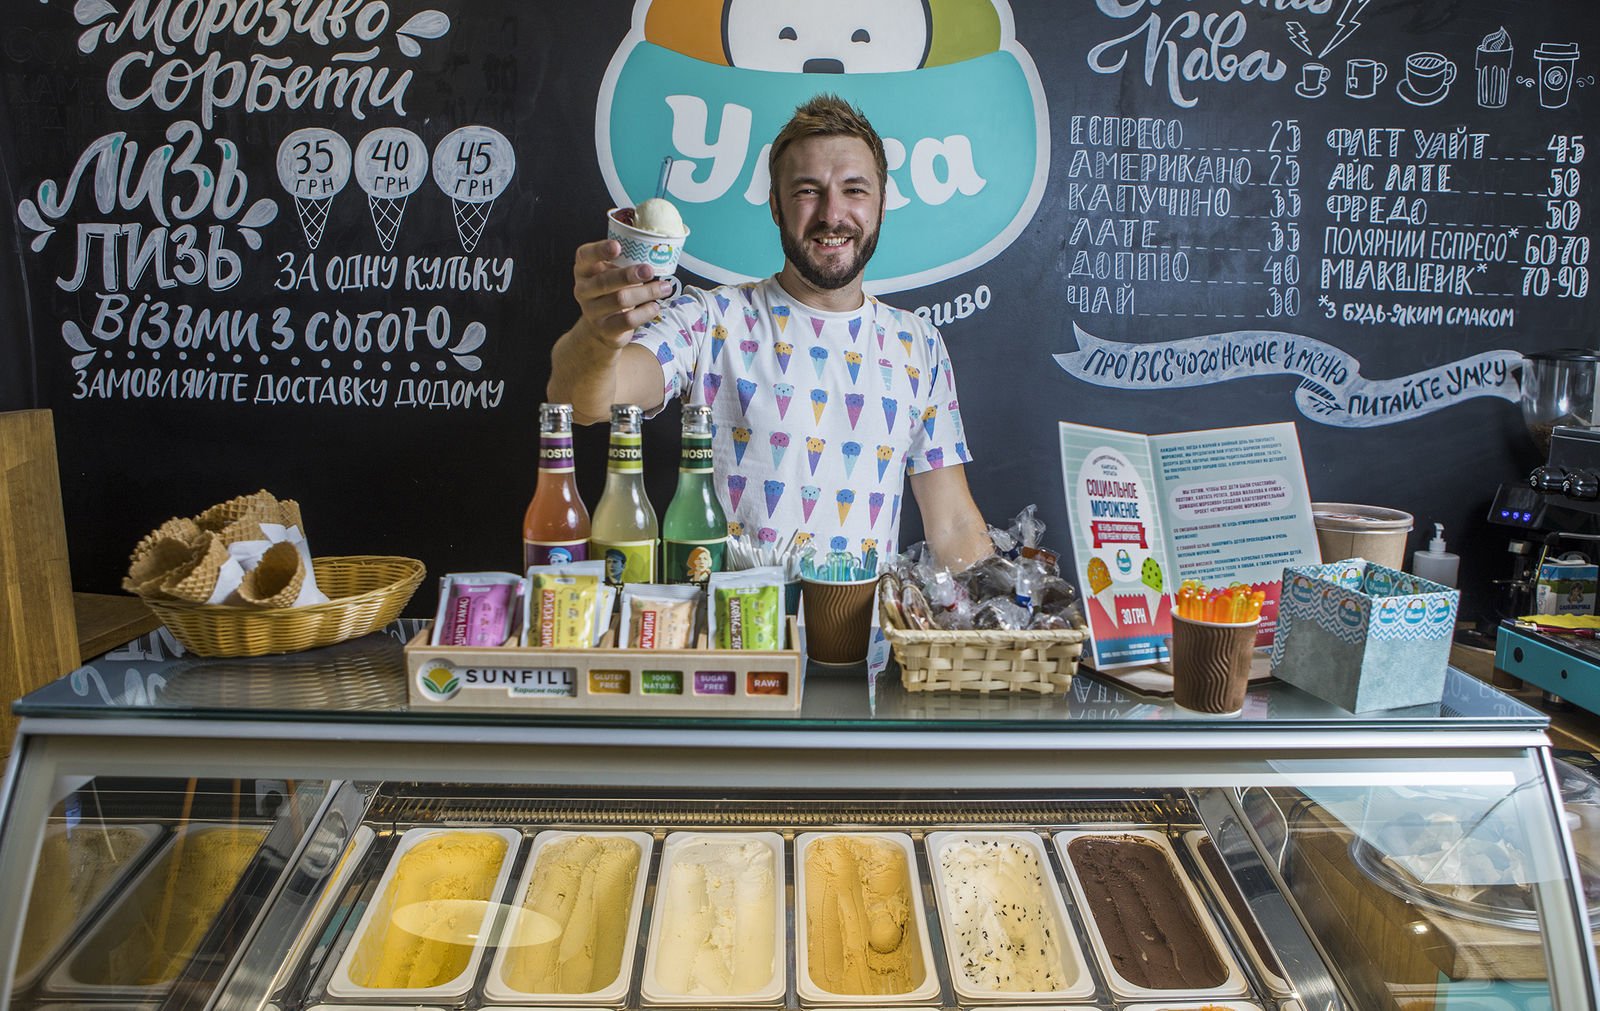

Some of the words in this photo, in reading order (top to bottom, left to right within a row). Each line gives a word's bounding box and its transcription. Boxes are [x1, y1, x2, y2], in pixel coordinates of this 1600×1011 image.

[1087, 10, 1287, 107] Кава
[1071, 116, 1183, 149] ЕСПРЕСО
[1269, 120, 1300, 152] 25
[1327, 128, 1405, 157] ФЛЕТ
[1414, 126, 1490, 159] УАЙТ
[1547, 134, 1585, 164] 45
[293, 140, 334, 174] 35
[370, 140, 409, 173] 40
[457, 141, 492, 175] 45
[1068, 150, 1251, 184] АМЕРИКАНО
[1269, 155, 1300, 186] 25
[296, 177, 334, 194] ГРН
[375, 176, 409, 192] ГРН
[455, 177, 493, 196] ГРН
[1327, 158, 1374, 191] АЙС
[1385, 164, 1451, 192] ЛАТЕ
[1547, 168, 1581, 198] 50
[1069, 183, 1230, 217] КАПУЧІНО
[1270, 189, 1300, 217] 35
[1327, 195, 1428, 225] ФРЕДО
[1546, 200, 1581, 230] 50
[1069, 218, 1160, 248] ЛАТЕ
[1268, 222, 1300, 251] 35
[1524, 234, 1590, 266] 60-70
[56, 223, 242, 291] ЛИЗЬ
[274, 252, 319, 291] ЗА
[326, 254, 398, 293] ОДНУ
[405, 256, 514, 292] КУЛЬКУ
[1068, 251, 1189, 282] ДОППІО
[1263, 254, 1300, 285] 40
[1520, 266, 1589, 298] 70-90
[1067, 283, 1134, 315] ЧАЙ
[1267, 287, 1300, 317] 30
[1342, 303, 1443, 328] БУДЬ-ЯКИМ
[1446, 306, 1515, 328] СМАКОМ
[1083, 348, 1128, 380] ПРО
[73, 367, 248, 402] ЗАМОВЛЯЙТЕ
[254, 374, 388, 408] ДОСТАВКУ
[394, 379, 504, 409] ДОДОМУ
[1348, 376, 1443, 416] ПИТАЙТЕ
[1446, 359, 1507, 396] УМКУ
[1086, 478, 1139, 500] СОЦИАЛЬНОЕ
[1090, 499, 1140, 519] МОРОЖЕНОЕ
[1121, 608, 1134, 625] 30
[1134, 608, 1147, 624] ГРН
[465, 669, 574, 685] SUNFILL
[754, 679, 780, 688] RAW!
